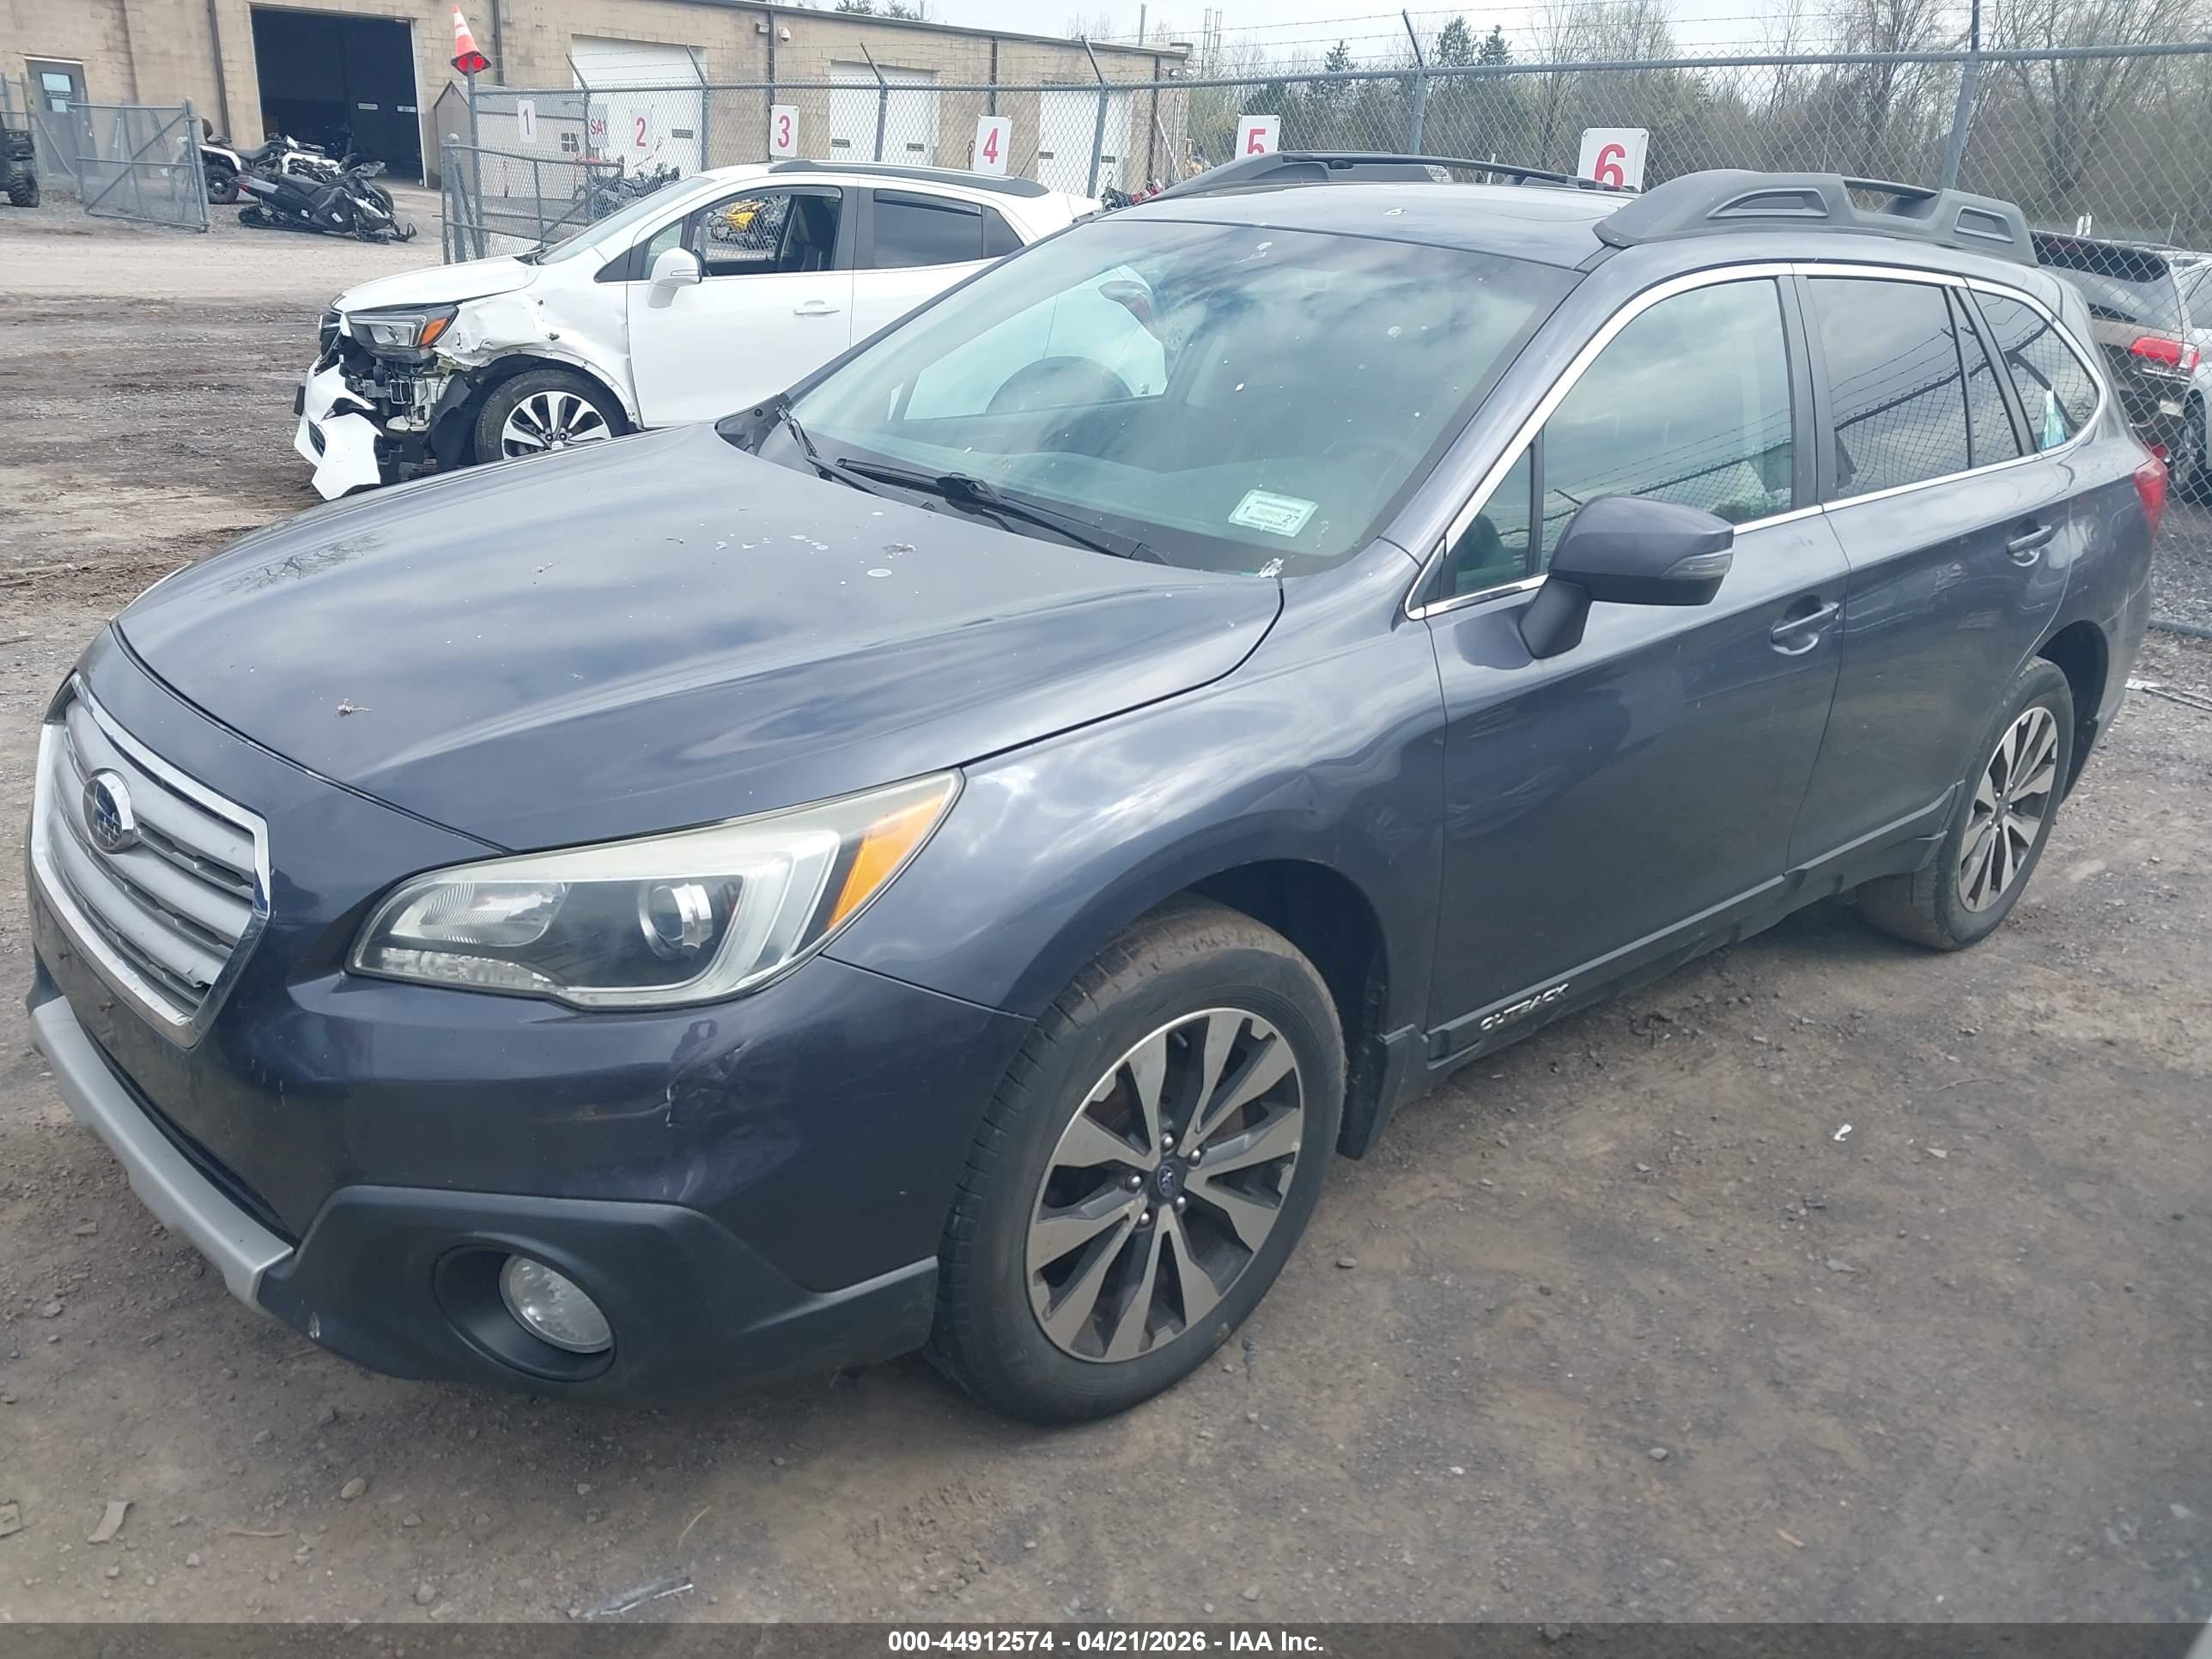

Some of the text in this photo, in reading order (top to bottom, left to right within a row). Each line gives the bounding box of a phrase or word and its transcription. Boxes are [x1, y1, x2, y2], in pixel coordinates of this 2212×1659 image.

[523, 108, 530, 136] 1
[635, 117, 647, 147] 2
[777, 114, 791, 148] 3
[982, 128, 1000, 164] 4
[1247, 129, 1266, 155] 5
[1594, 143, 1626, 187] 6
[1283, 514, 1299, 524] 27
